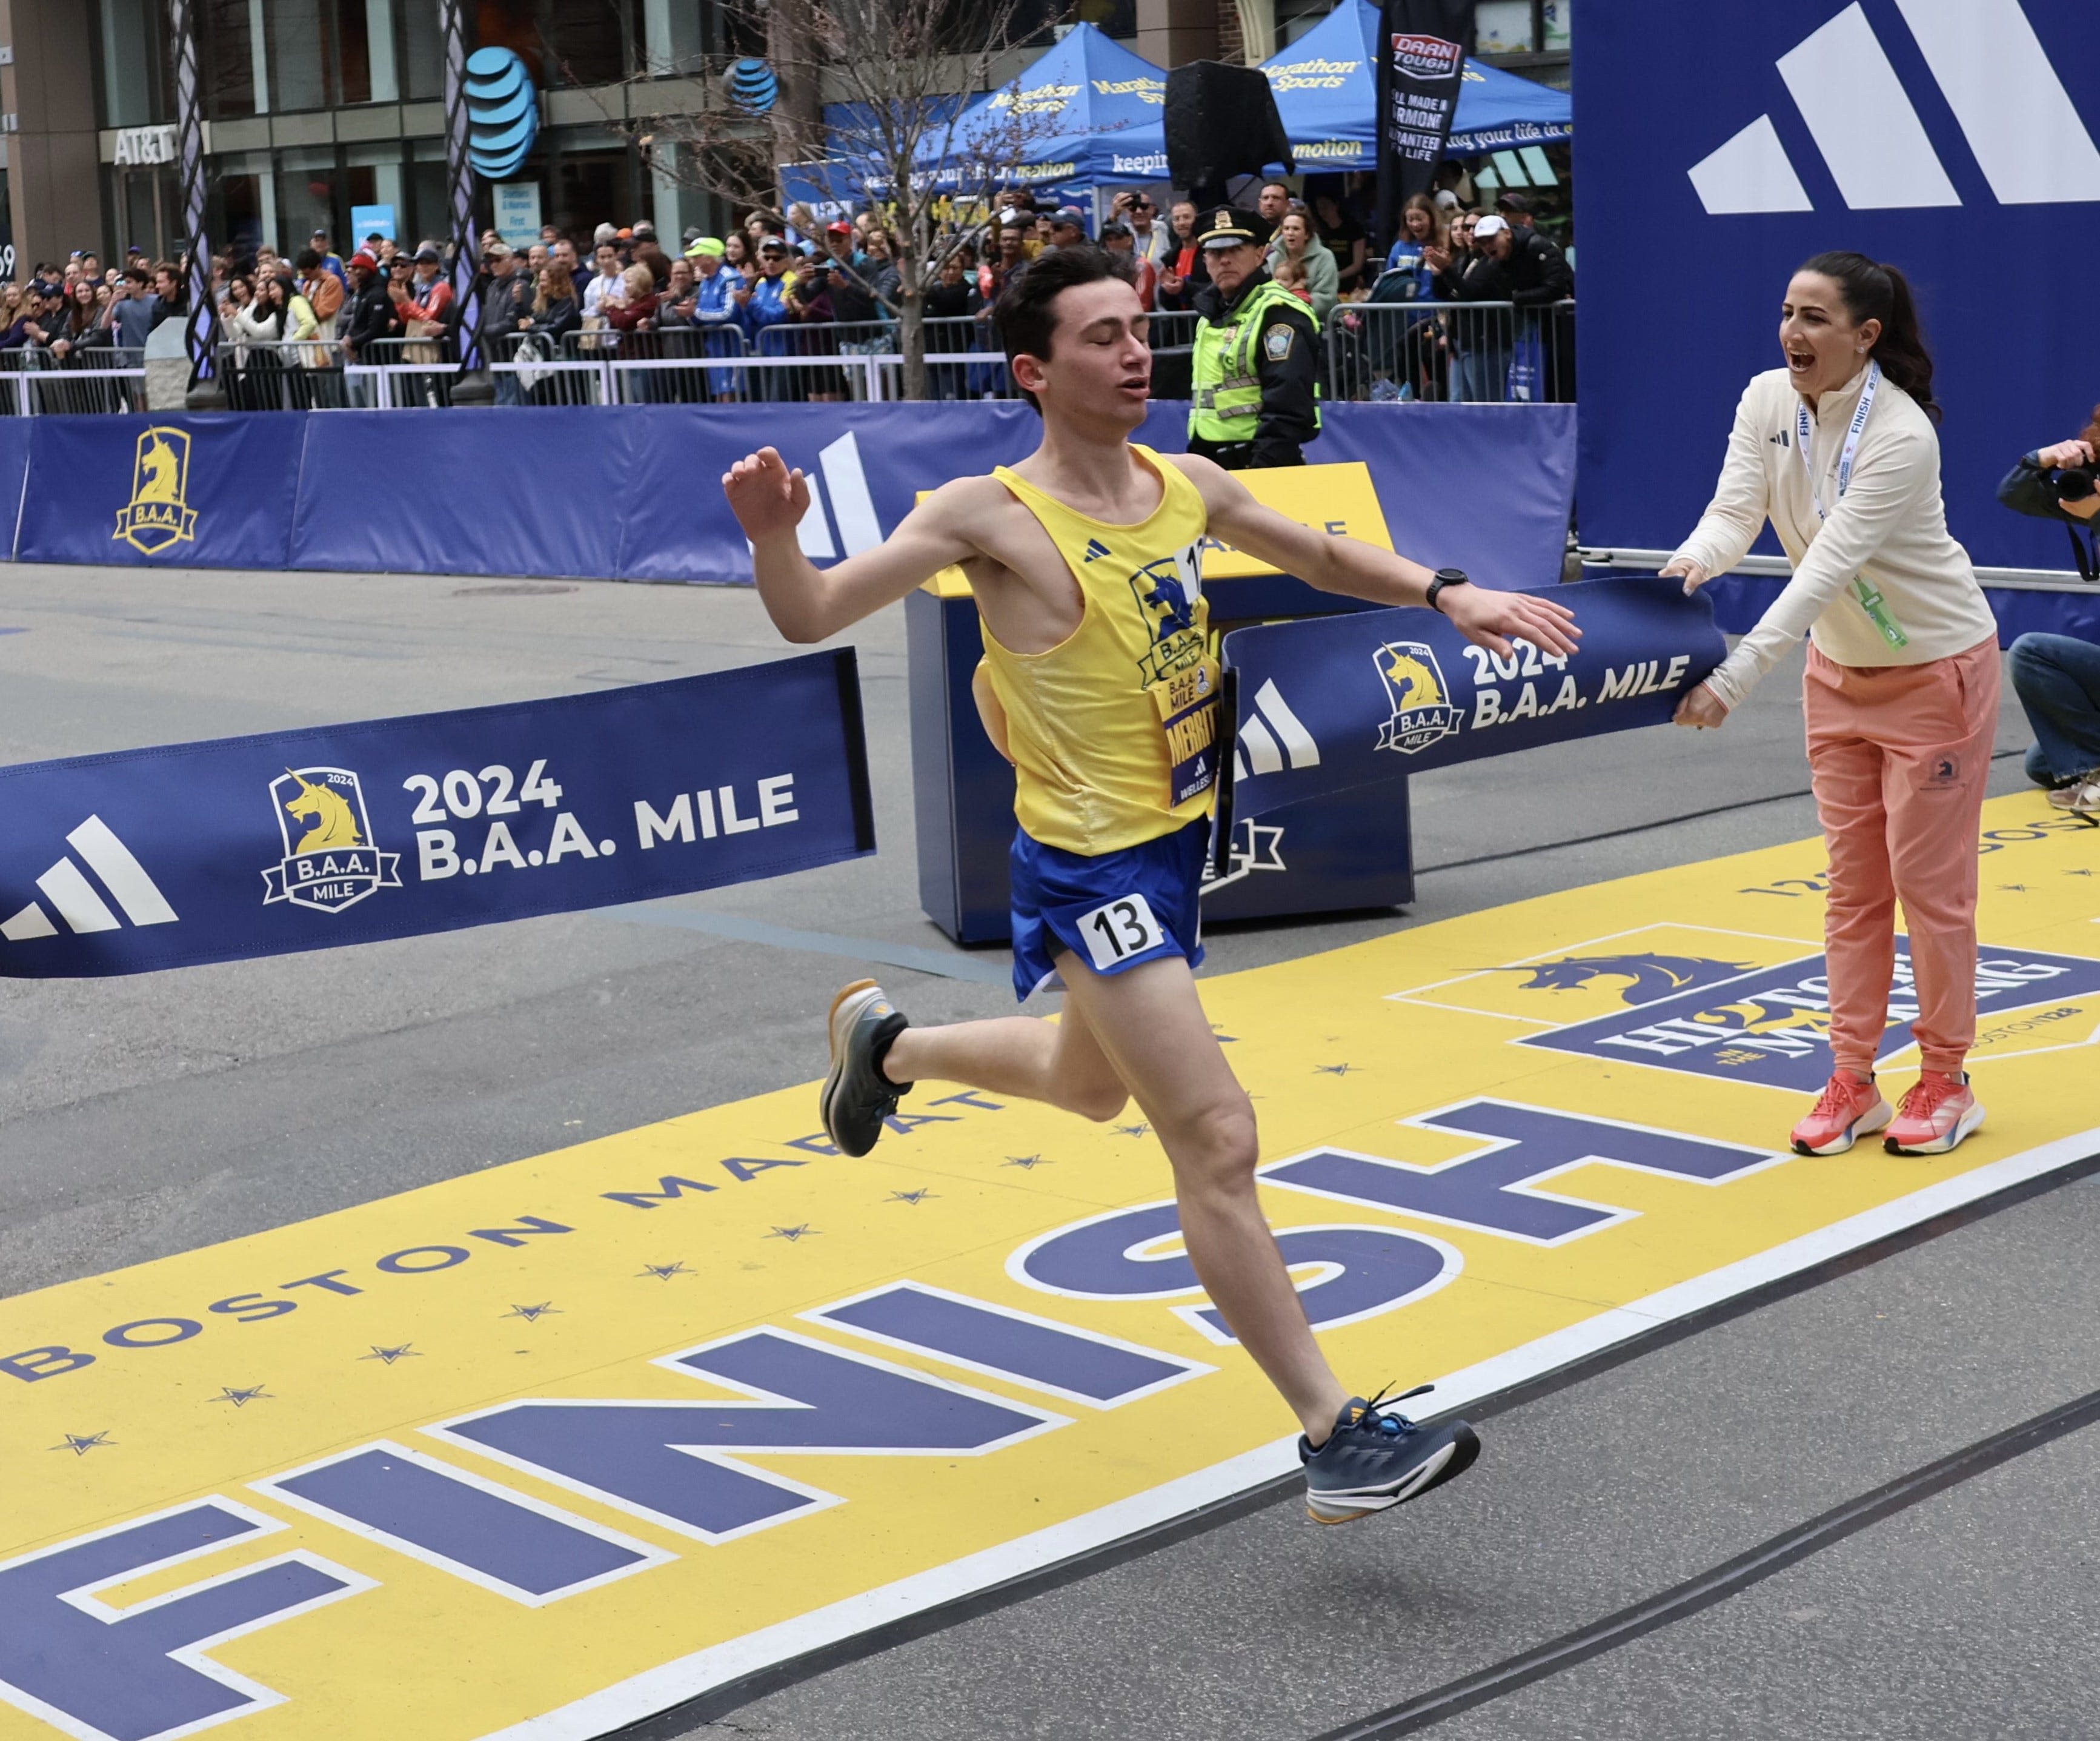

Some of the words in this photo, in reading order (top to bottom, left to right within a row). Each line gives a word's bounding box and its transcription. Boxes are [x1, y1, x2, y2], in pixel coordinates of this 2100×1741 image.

[1396, 38, 1454, 59] DARN
[1394, 50, 1450, 71] TOUGH
[1091, 76, 1167, 95] Maratho
[1272, 75, 1346, 92] Sports
[1407, 94, 1439, 111] MADE
[114, 124, 176, 165] AT&T
[1474, 129, 1514, 149] your
[1514, 122, 1544, 140] life
[1544, 121, 1563, 137] in
[1292, 137, 1363, 158] motion
[1405, 147, 1433, 162] LIFE
[1851, 397, 1871, 434] FINISH
[135, 504, 178, 525] B.A.A.
[1186, 537, 1203, 592] 1
[1409, 646, 1429, 657] 2024
[1170, 686, 1194, 712] MILE
[1470, 675, 1587, 730] B.A.A.
[1596, 655, 1690, 704] MILE
[1400, 709, 1444, 732] B.A.A.
[1404, 732, 1432, 747] MILE
[327, 774, 354, 787] 2024
[402, 758, 563, 825] 2024
[416, 812, 617, 881] B.A.A.
[634, 773, 799, 849] MILE
[296, 853, 370, 881] B.A.A.
[313, 882, 354, 901] MILE
[1093, 901, 1149, 957] 13
[0, 1215, 577, 1383] BOSTON
[0, 1098, 1789, 1741] FINISH
